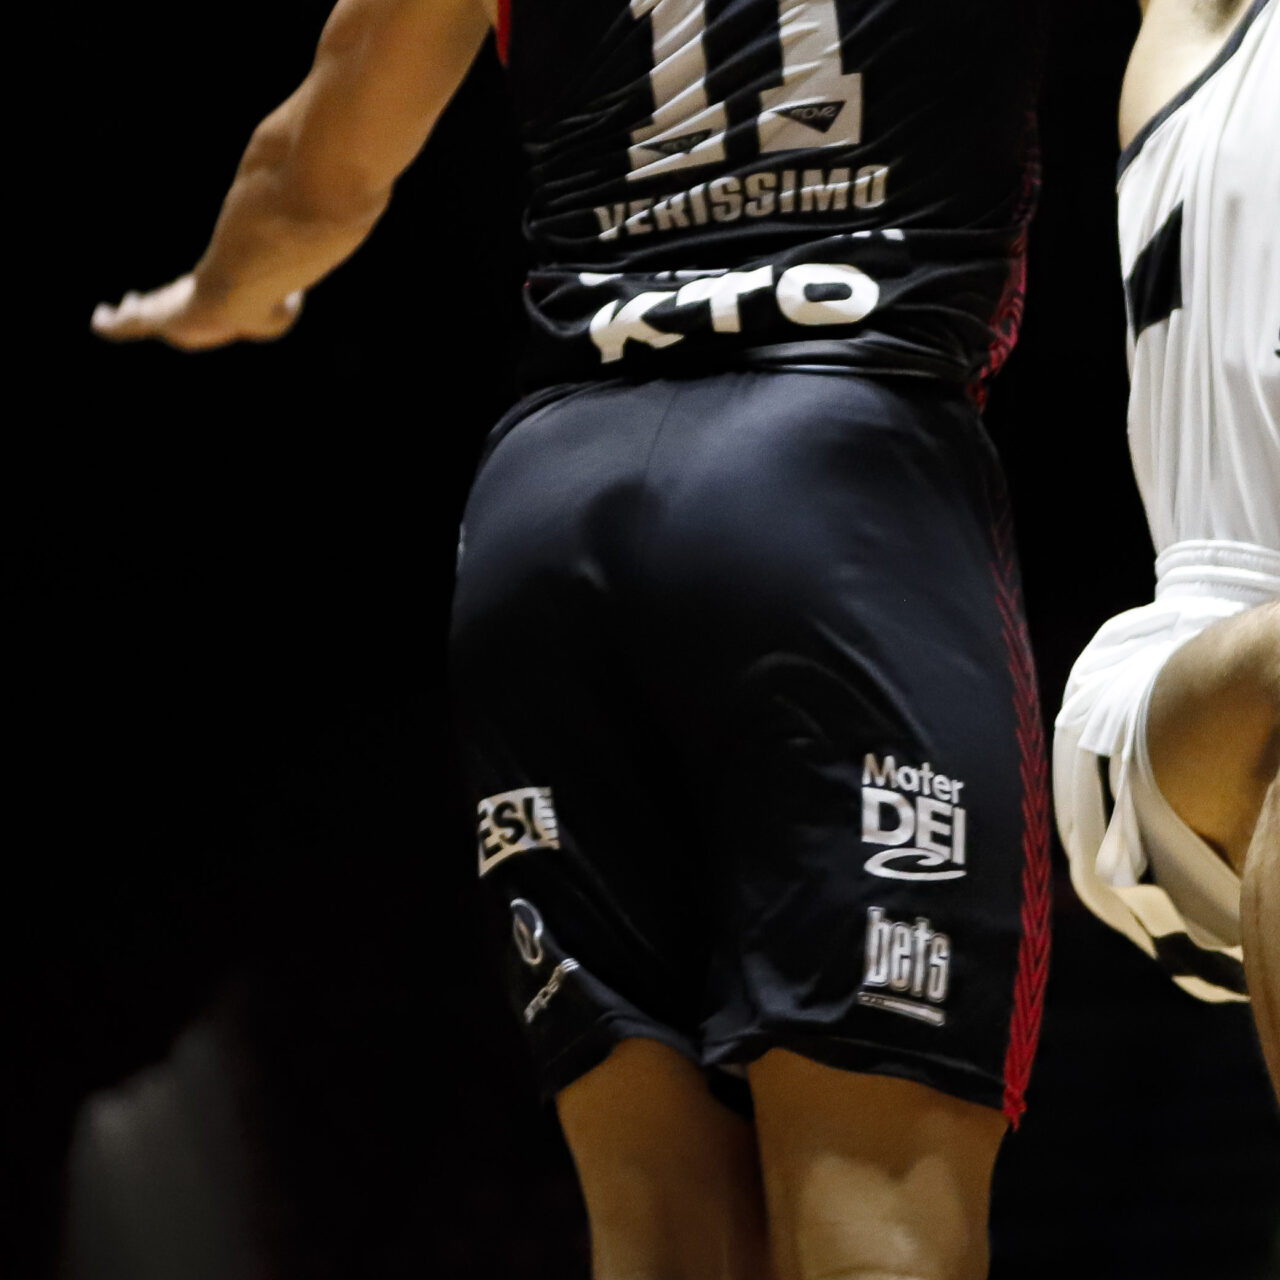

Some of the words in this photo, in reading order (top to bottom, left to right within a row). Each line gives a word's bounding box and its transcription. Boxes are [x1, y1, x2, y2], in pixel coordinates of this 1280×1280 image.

[594, 165, 889, 241] VERISSIMO
[589, 264, 880, 363] KTO
[862, 753, 965, 803] Mater
[861, 787, 966, 864] DEI
[863, 906, 950, 1003] bets
